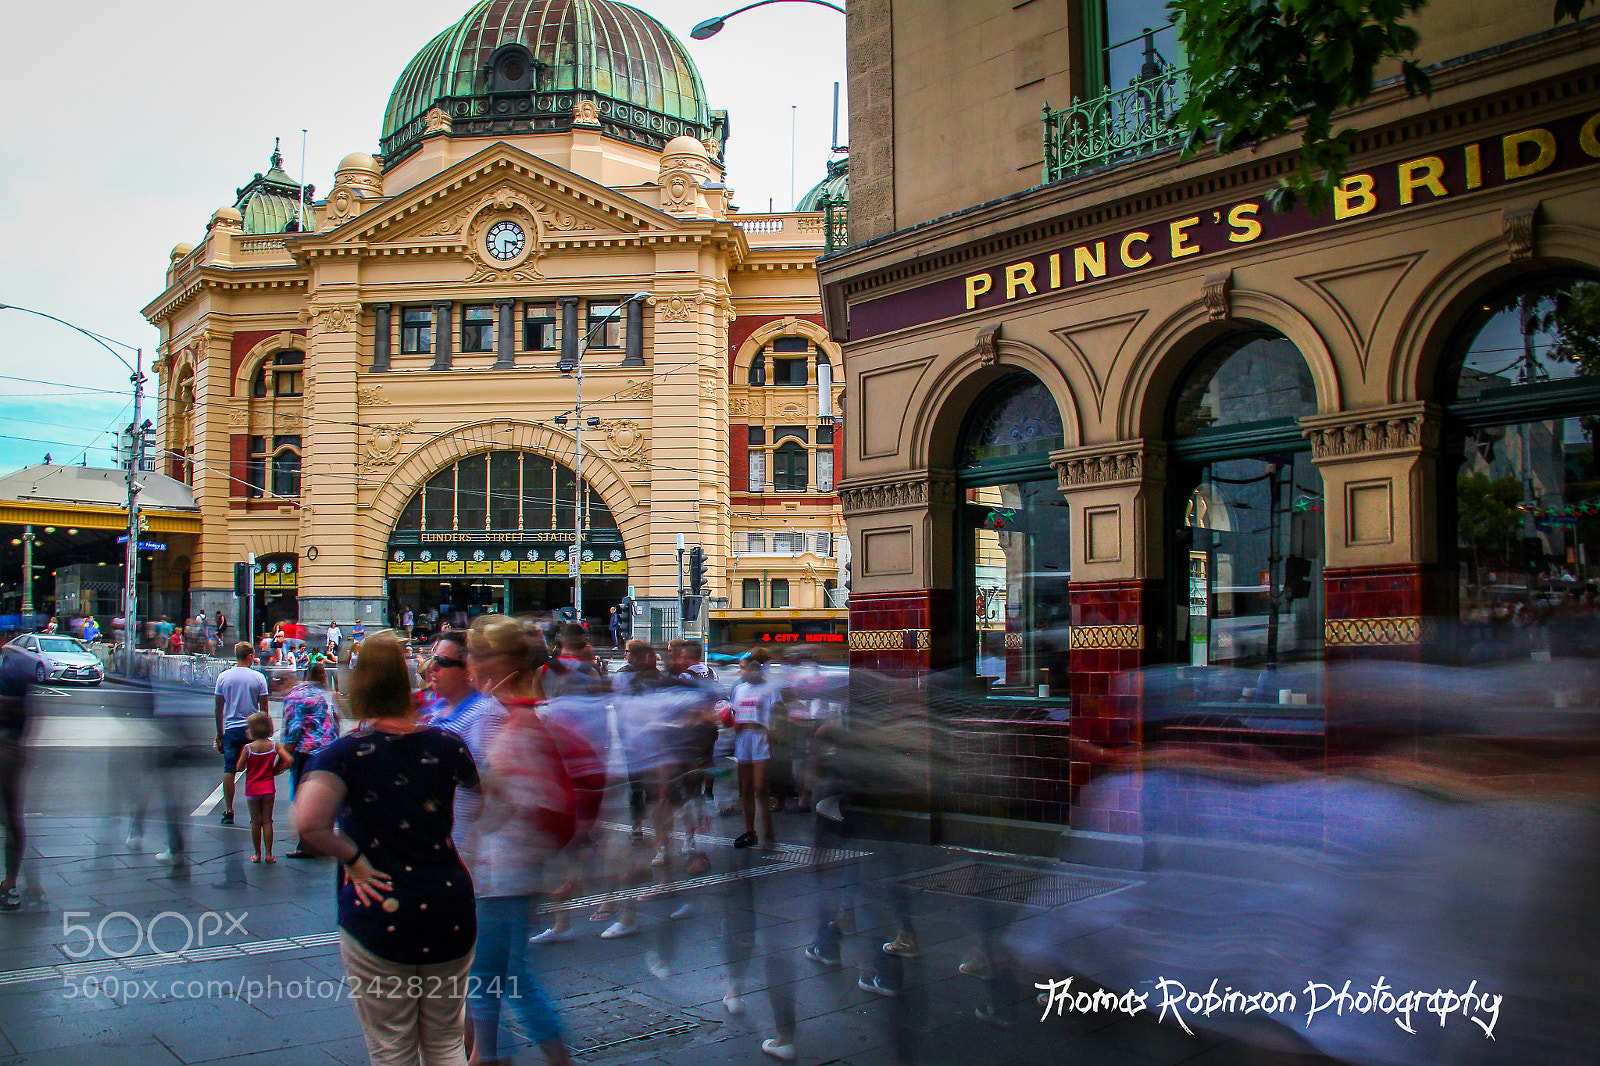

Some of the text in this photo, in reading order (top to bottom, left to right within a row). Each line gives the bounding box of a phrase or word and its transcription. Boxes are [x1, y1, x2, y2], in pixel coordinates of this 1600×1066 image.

[964, 203, 1264, 310] PRINCE'S
[421, 533, 472, 542] FLINDERS
[485, 533, 525, 542] STREET
[774, 633, 799, 642] CITY
